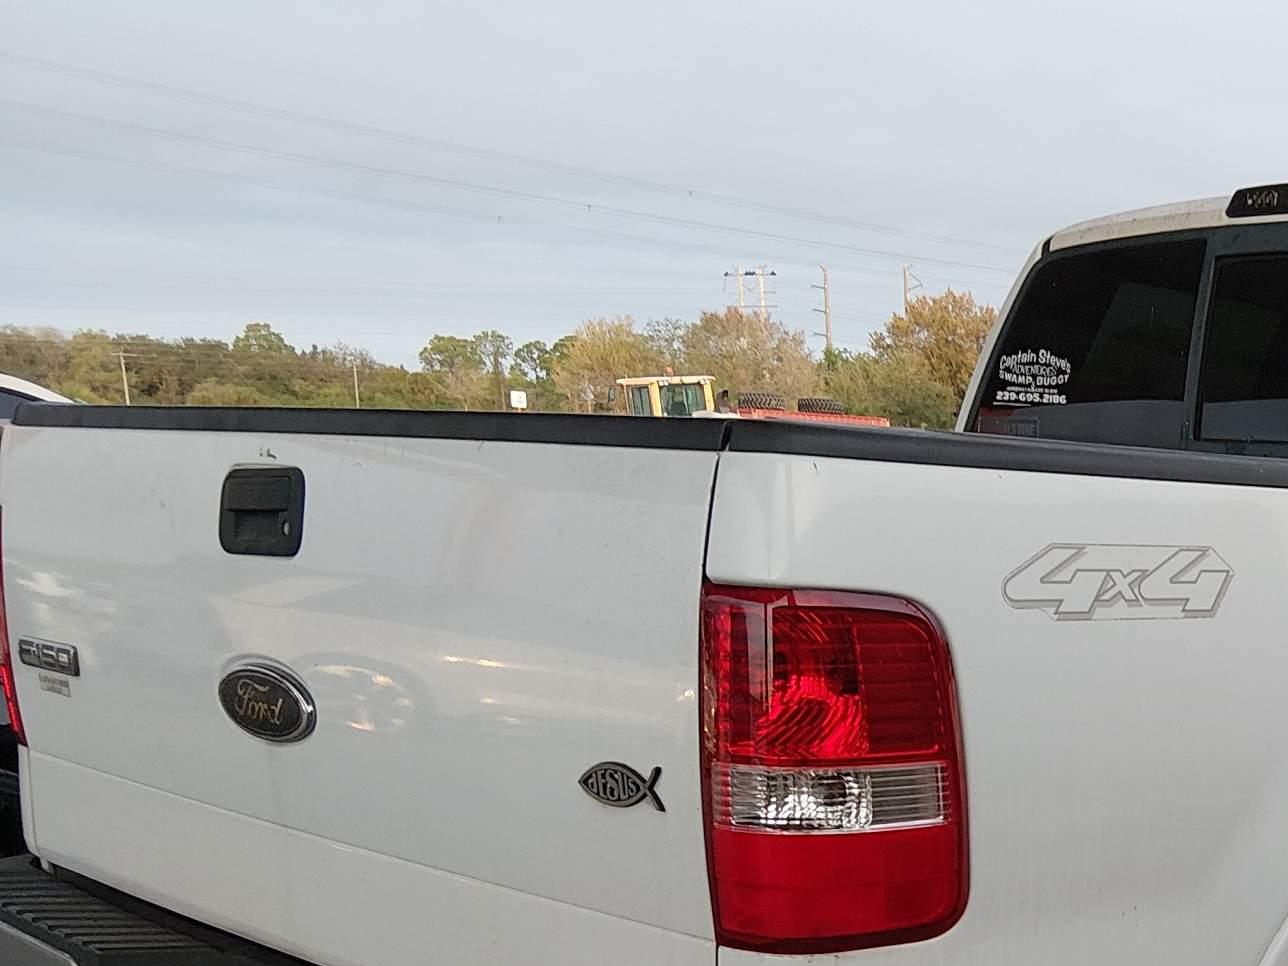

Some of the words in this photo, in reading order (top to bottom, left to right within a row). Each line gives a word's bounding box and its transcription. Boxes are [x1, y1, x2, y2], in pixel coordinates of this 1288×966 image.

[999, 369, 1033, 385] SWAMP
[1036, 374, 1070, 386] BUGGY
[1000, 349, 1037, 369] Captain
[1038, 348, 1071, 374] Steve's
[1001, 544, 1235, 620] 4x4
[235, 678, 284, 726] Ford
[587, 768, 638, 801] JESUS
